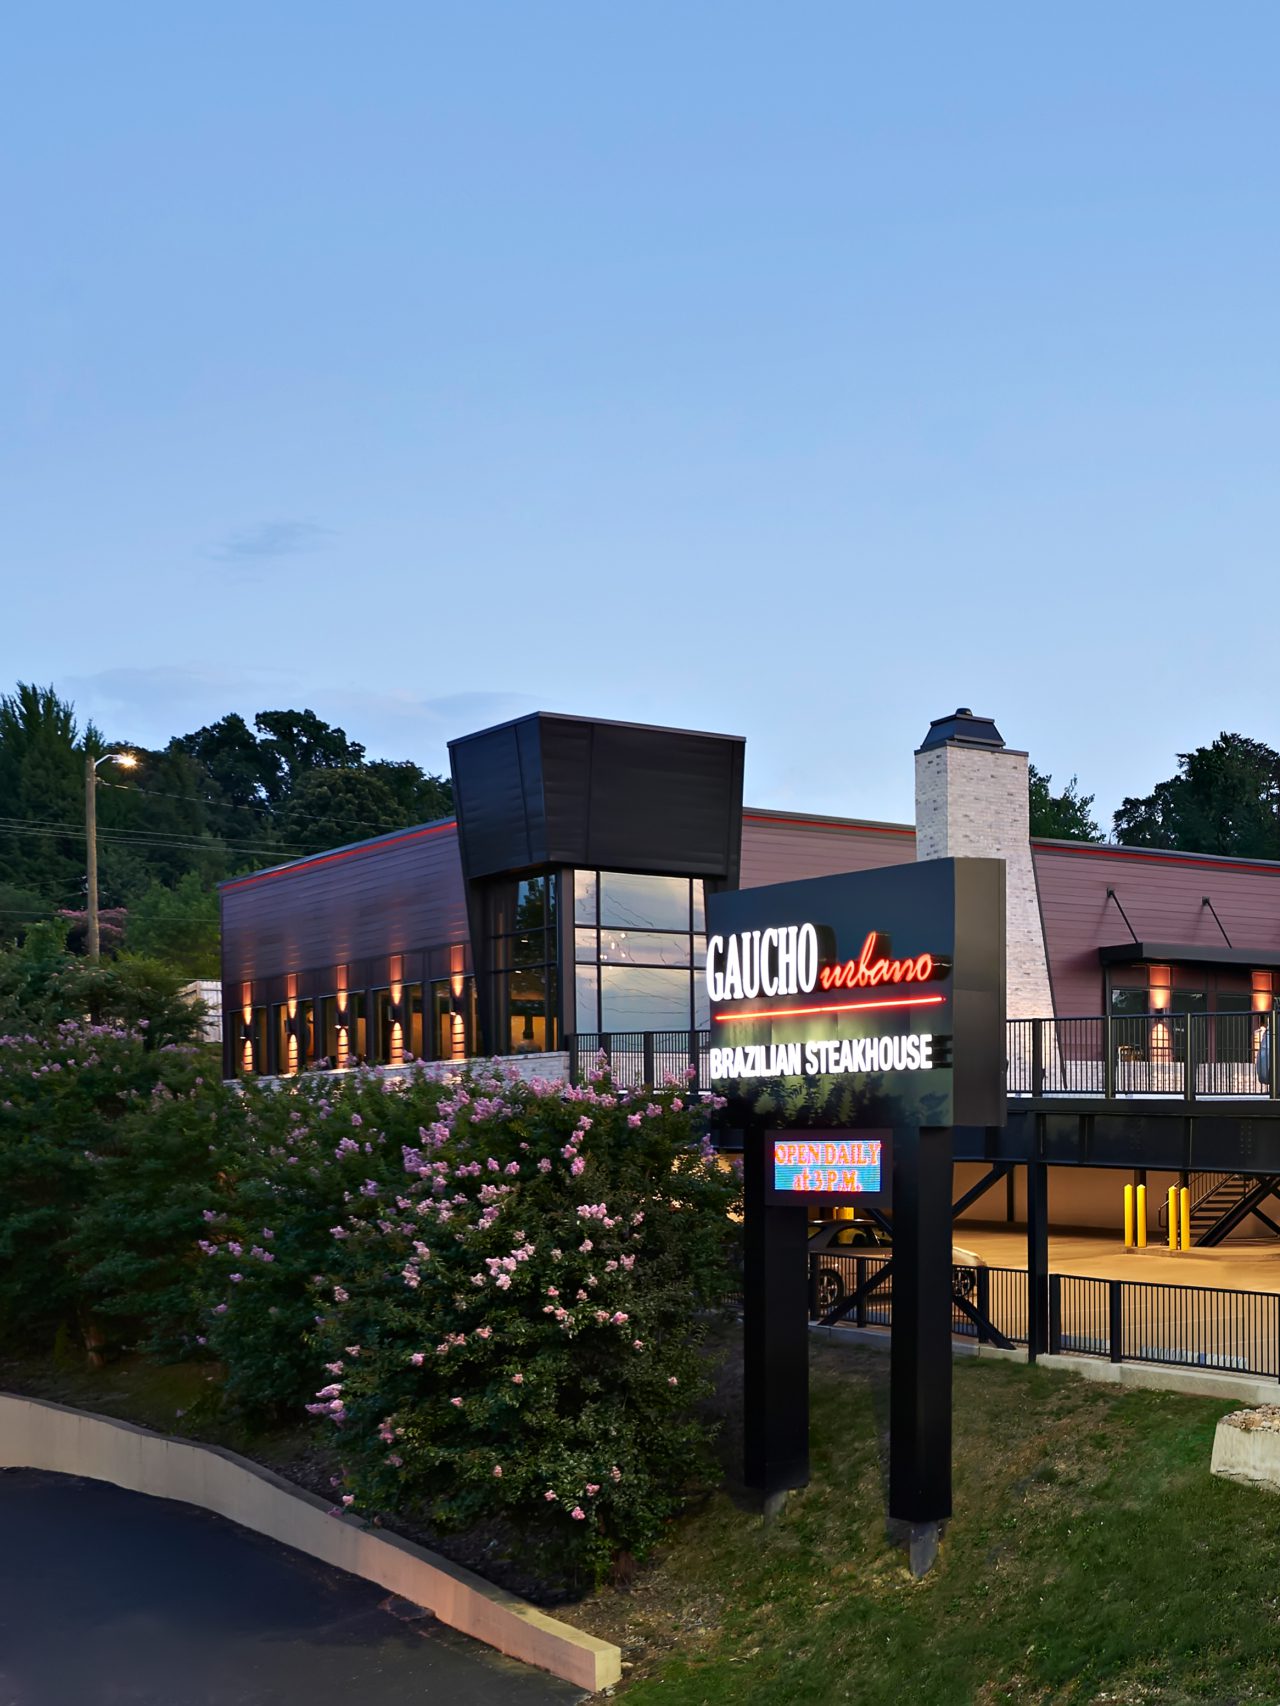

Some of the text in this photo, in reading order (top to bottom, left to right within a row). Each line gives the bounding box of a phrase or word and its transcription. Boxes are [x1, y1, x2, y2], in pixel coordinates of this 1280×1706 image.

[706, 923, 933, 1001] GAUCHO urbano
[710, 1034, 932, 1079] BRAZILIAN STEAKHOUSE
[775, 1143, 881, 1164] OPEN DAILY
[793, 1167, 811, 1191] at
[813, 1169, 824, 1191] 3
